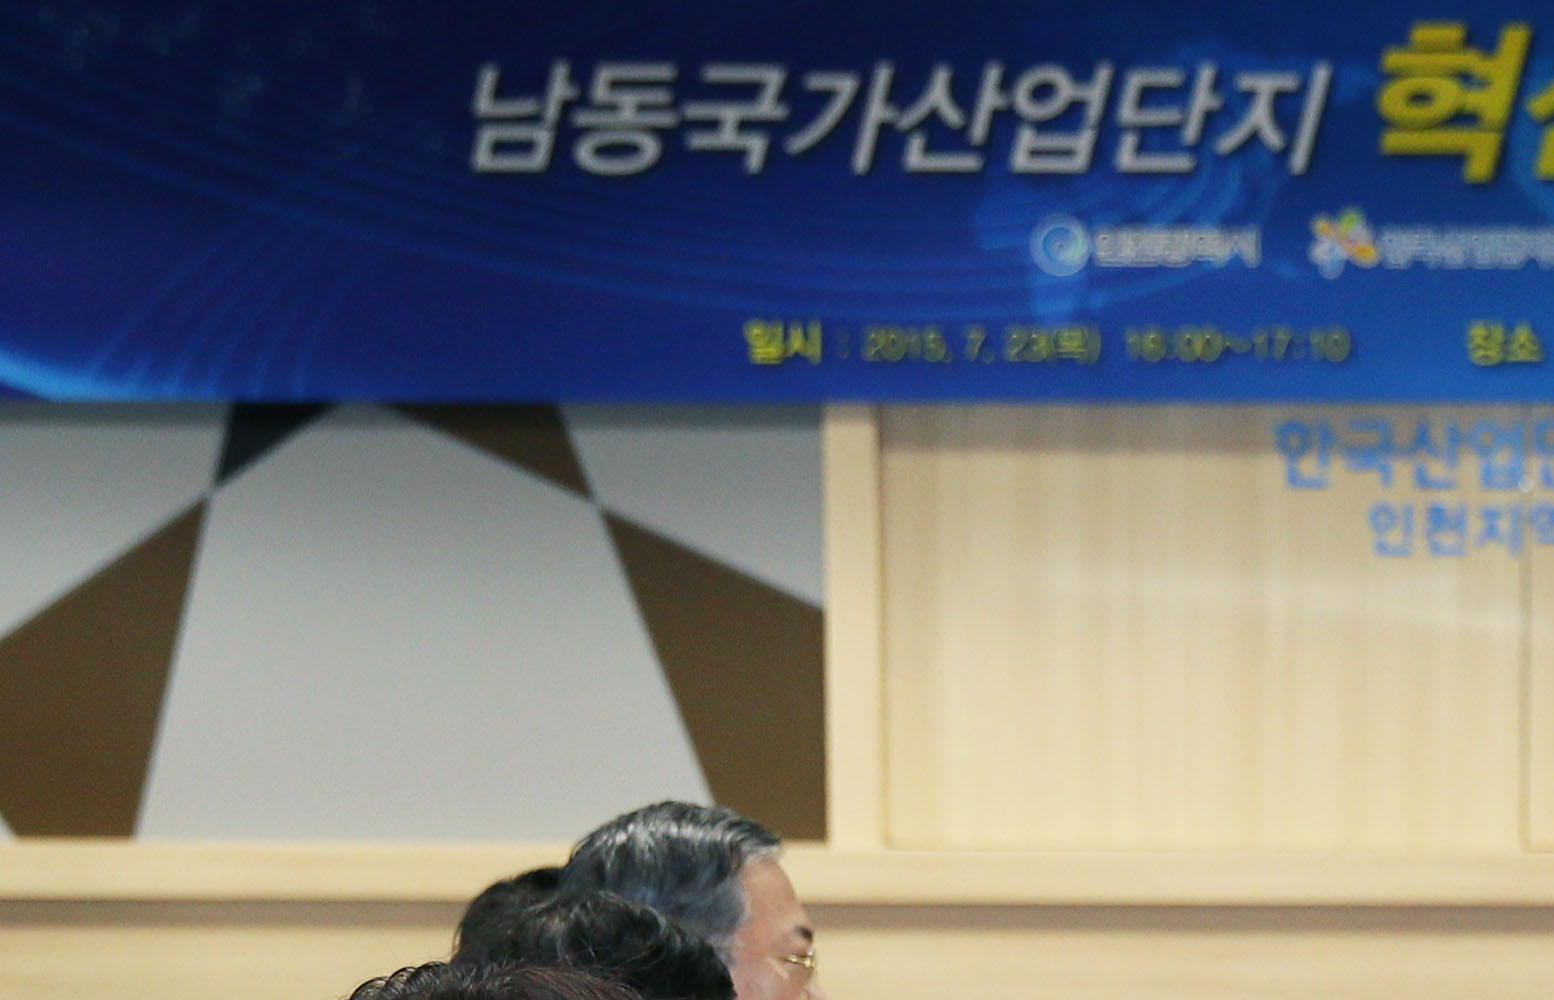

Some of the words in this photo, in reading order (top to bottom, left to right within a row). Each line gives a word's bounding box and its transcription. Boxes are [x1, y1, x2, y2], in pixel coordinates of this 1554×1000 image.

[471, 60, 1335, 176] 남동국가산업단지
[744, 318, 823, 366] 일시
[1467, 319, 1545, 367] 장소
